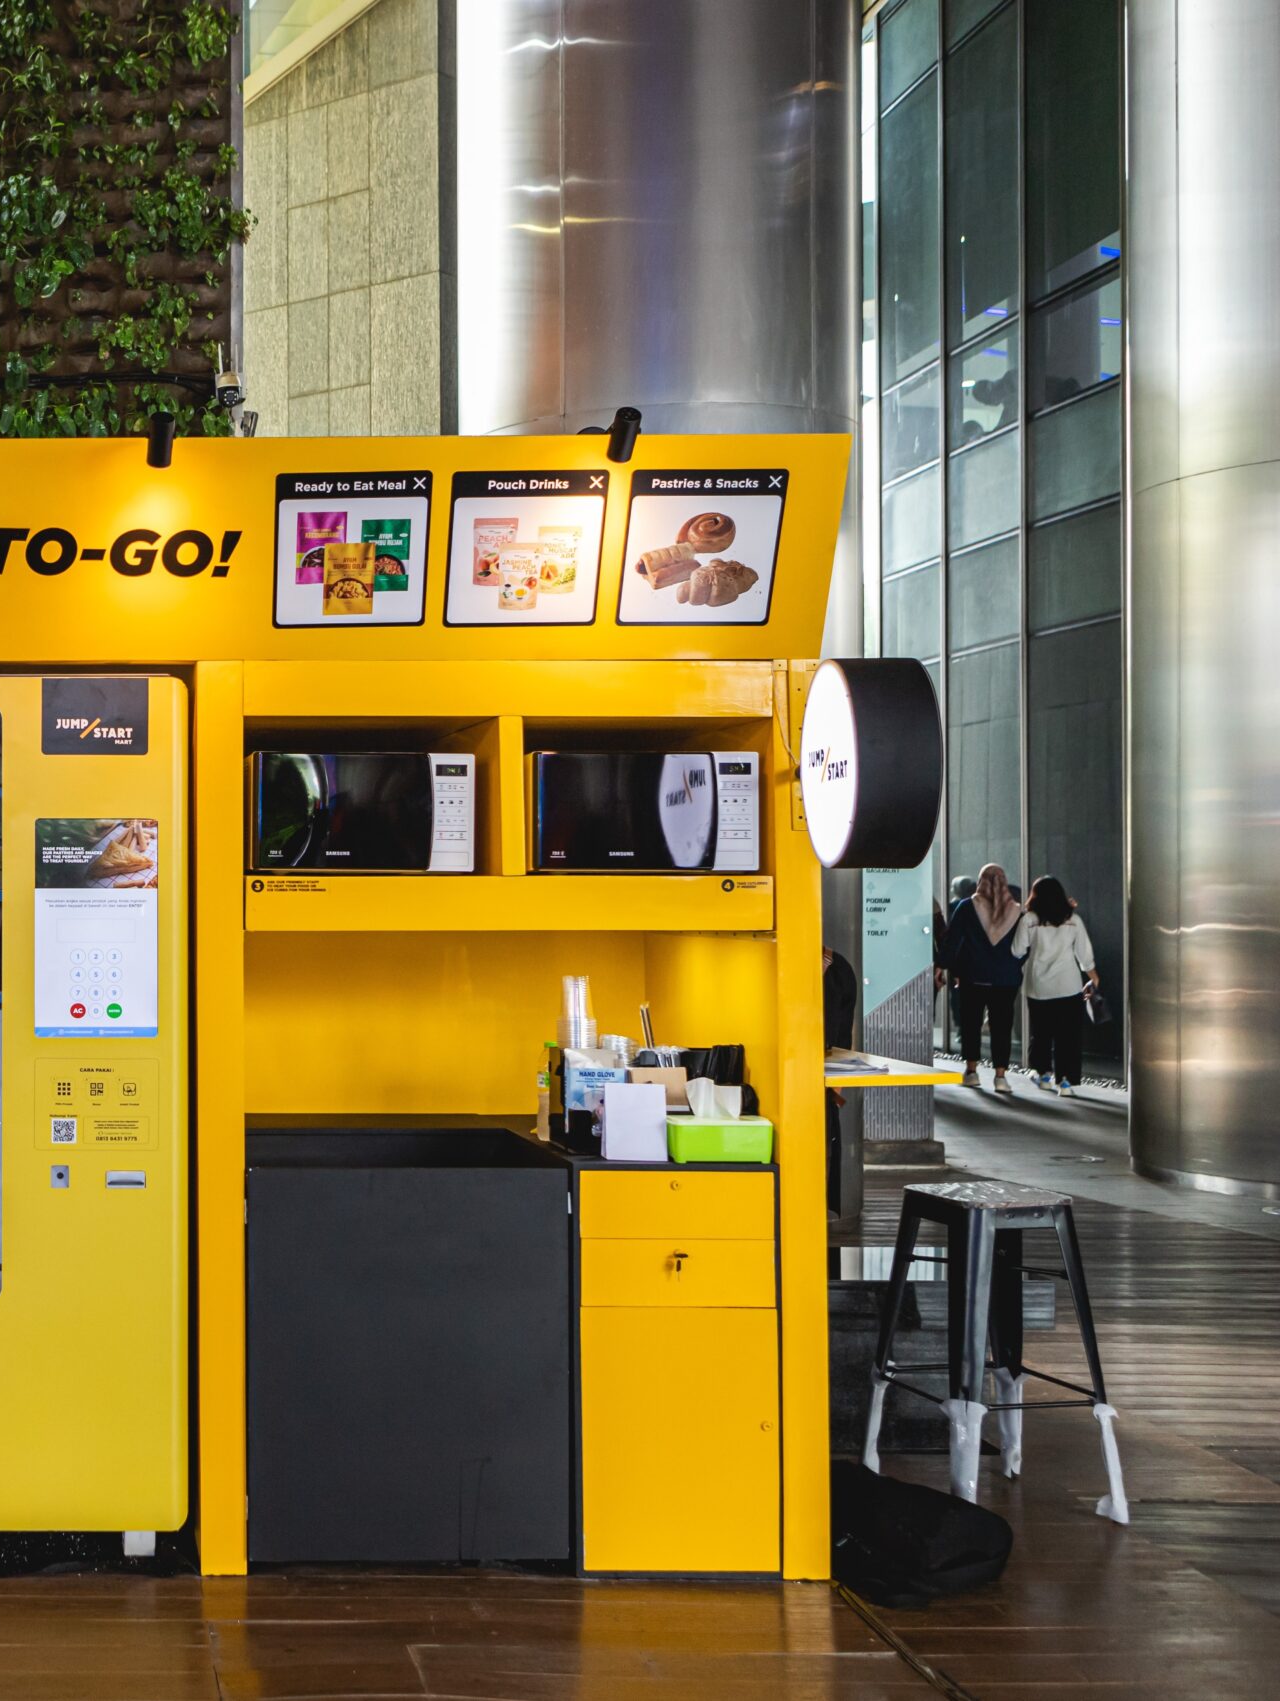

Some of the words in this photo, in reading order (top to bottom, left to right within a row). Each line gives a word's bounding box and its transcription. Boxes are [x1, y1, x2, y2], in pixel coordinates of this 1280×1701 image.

[295, 482, 333, 494] Ready
[337, 482, 350, 491] to
[354, 481, 374, 491] Eat
[378, 480, 406, 490] Meal
[488, 479, 527, 490] Pouch
[529, 479, 569, 489] Drinks
[651, 478, 700, 489] Pastries
[704, 479, 713, 489] &
[716, 478, 759, 489] Snacks
[478, 535, 509, 543] PEACH
[56, 718, 89, 729] JUMP
[93, 727, 133, 738] START
[808, 749, 824, 768] JUMP
[828, 760, 848, 781] START
